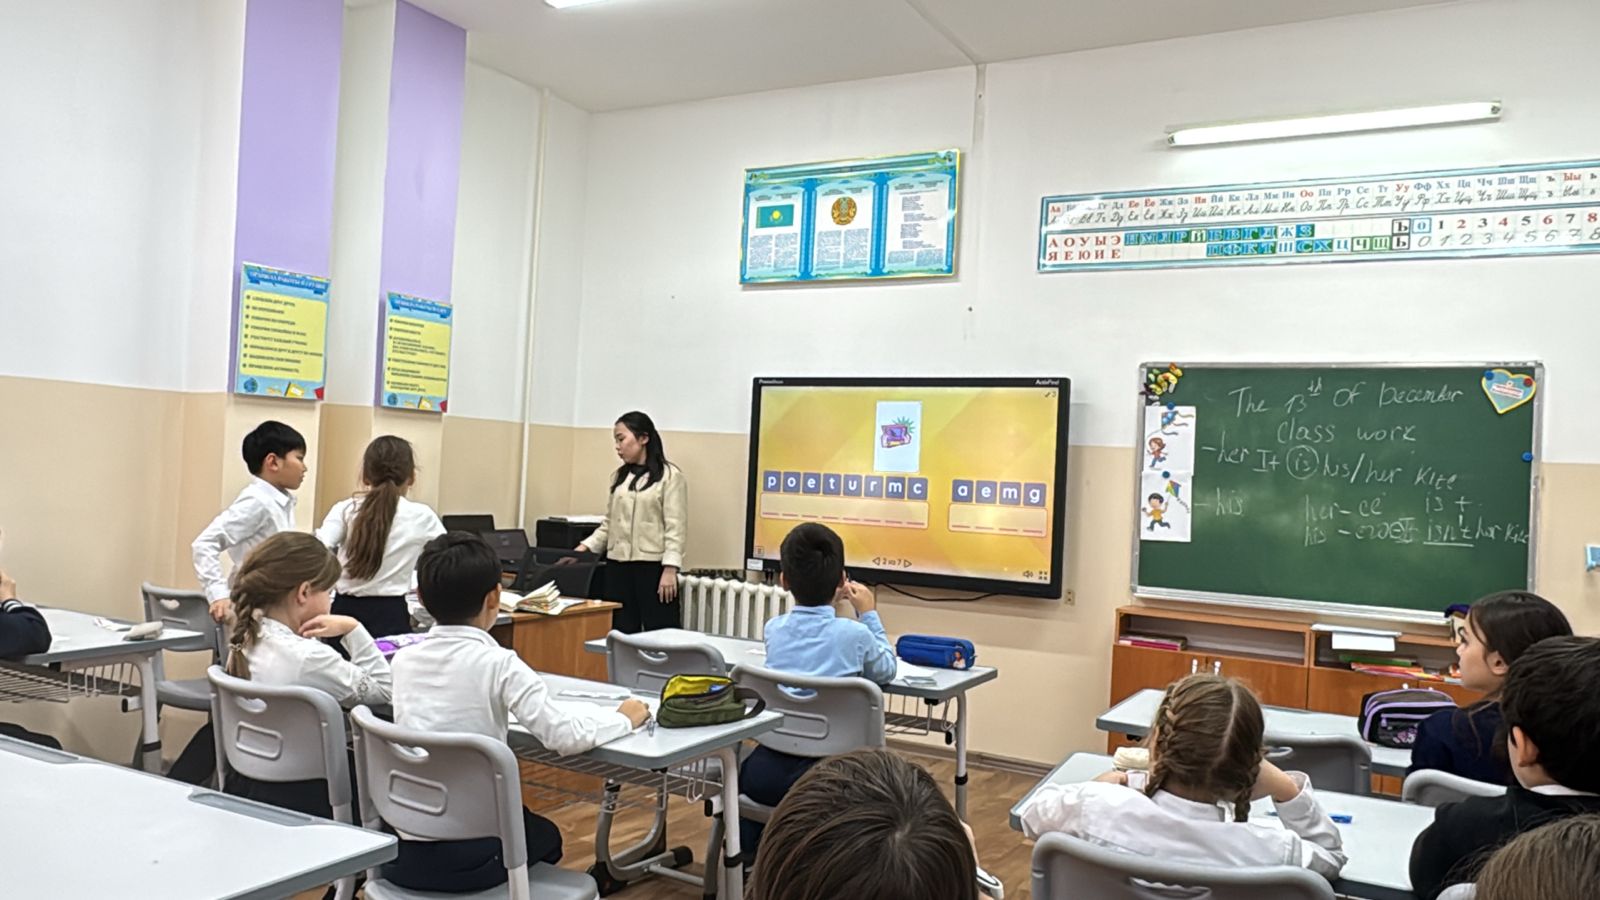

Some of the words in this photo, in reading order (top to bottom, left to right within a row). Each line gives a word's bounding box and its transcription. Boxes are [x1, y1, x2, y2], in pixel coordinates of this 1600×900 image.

[1438, 220, 1444, 229] 1
[1457, 219, 1466, 229] 2
[1477, 218, 1488, 228] 3
[1498, 217, 1508, 226] 4
[1521, 216, 1531, 226] 5
[1542, 215, 1553, 225] 6
[1565, 213, 1576, 223] 7
[1587, 212, 1598, 222] 8
[1461, 233, 1472, 245] 2
[1482, 232, 1493, 244] 3
[1503, 232, 1515, 243] 4
[1524, 230, 1537, 242] 5
[1545, 229, 1559, 242] 6
[1589, 227, 1600, 240] 8
[1228, 386, 1269, 418] The
[1380, 381, 1463, 408] December
